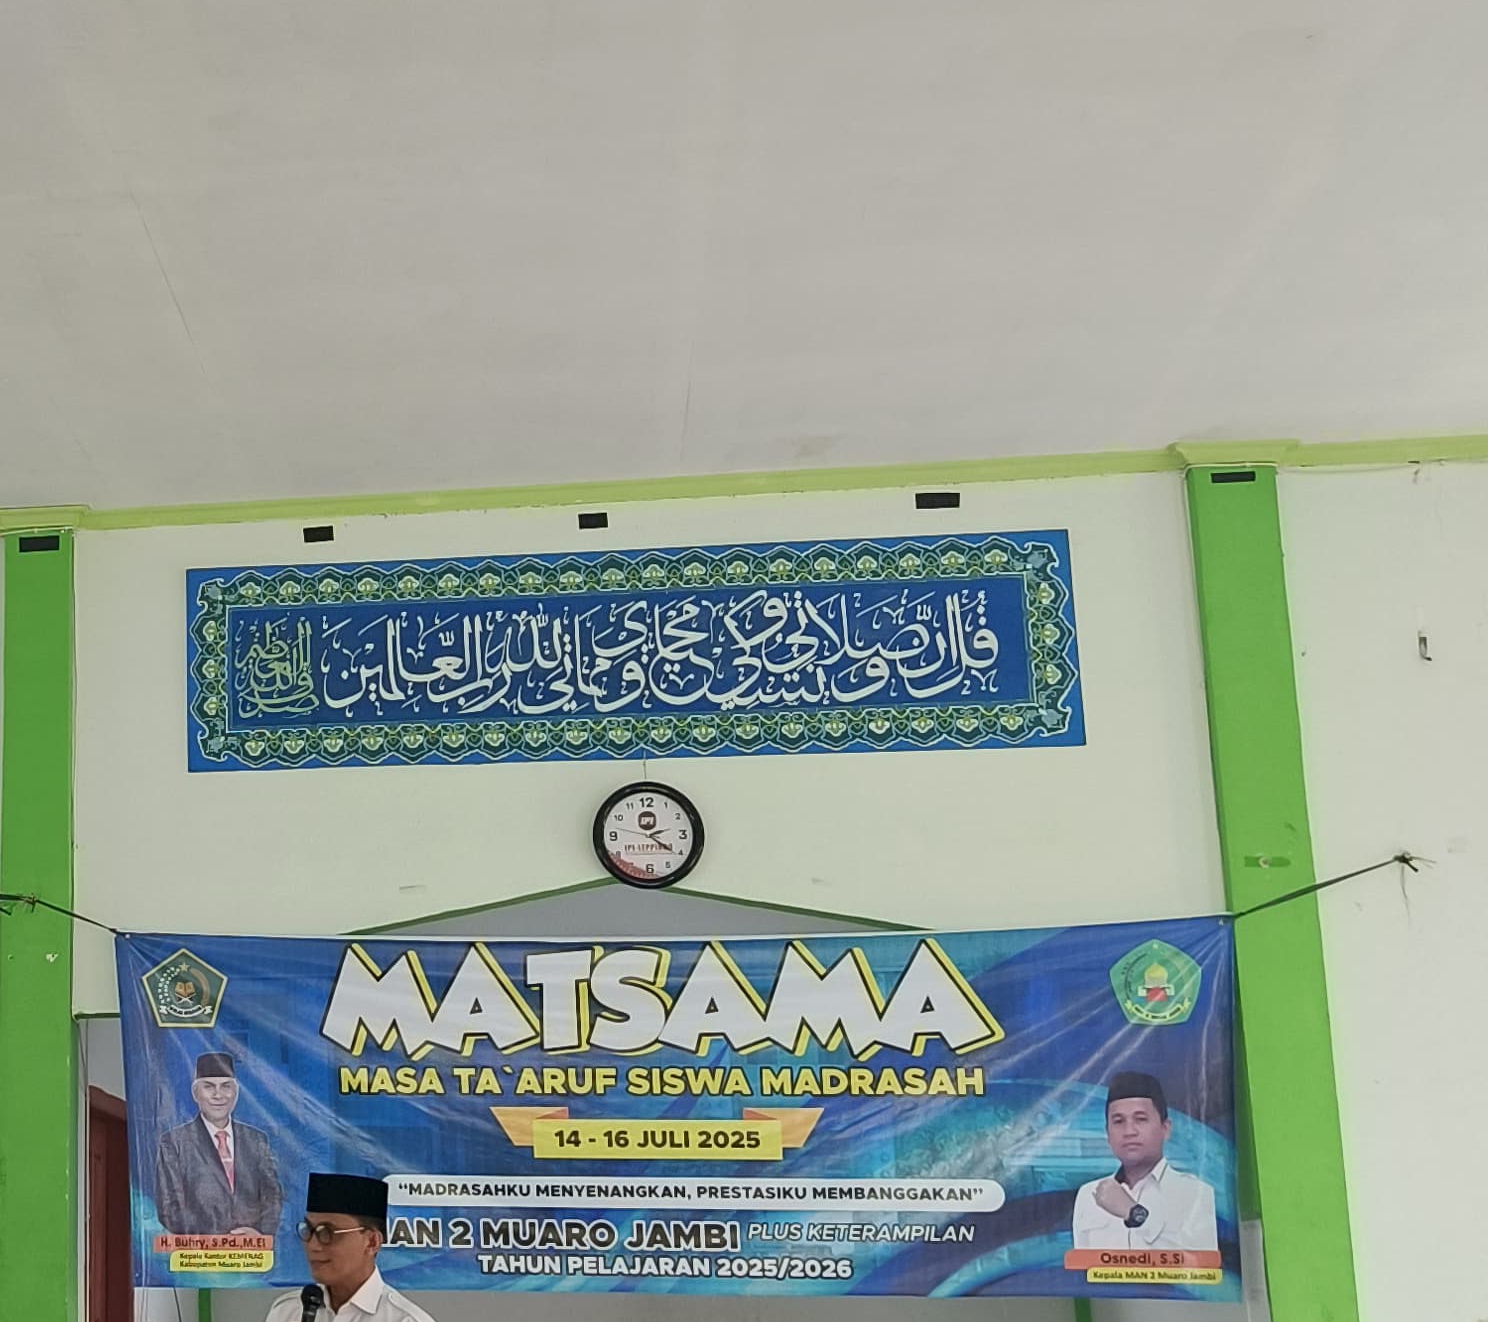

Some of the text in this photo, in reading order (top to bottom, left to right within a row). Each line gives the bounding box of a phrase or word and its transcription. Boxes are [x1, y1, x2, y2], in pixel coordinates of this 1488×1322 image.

[639, 797, 654, 808] 12
[609, 831, 618, 841] 9
[679, 830, 687, 840] 3
[646, 864, 654, 874] 6
[319, 938, 1006, 1061] MATSAMA
[339, 1067, 444, 1095] MASA
[627, 1068, 751, 1095] SISWA
[761, 1067, 984, 1096] MADRASAH
[554, 1130, 581, 1148] 14
[603, 1130, 629, 1148] 16
[637, 1130, 690, 1149] JULI
[697, 1130, 761, 1149] 2025
[535, 1184, 692, 1200] MENYENANGKAN,
[696, 1186, 807, 1200] PRESTASIKU
[384, 1217, 975, 1252] AN 2 MUARO JAMBI PLUS KETERAMPILAN
[478, 1254, 853, 1280] TAHUN PELAJARAN 2025/2026
